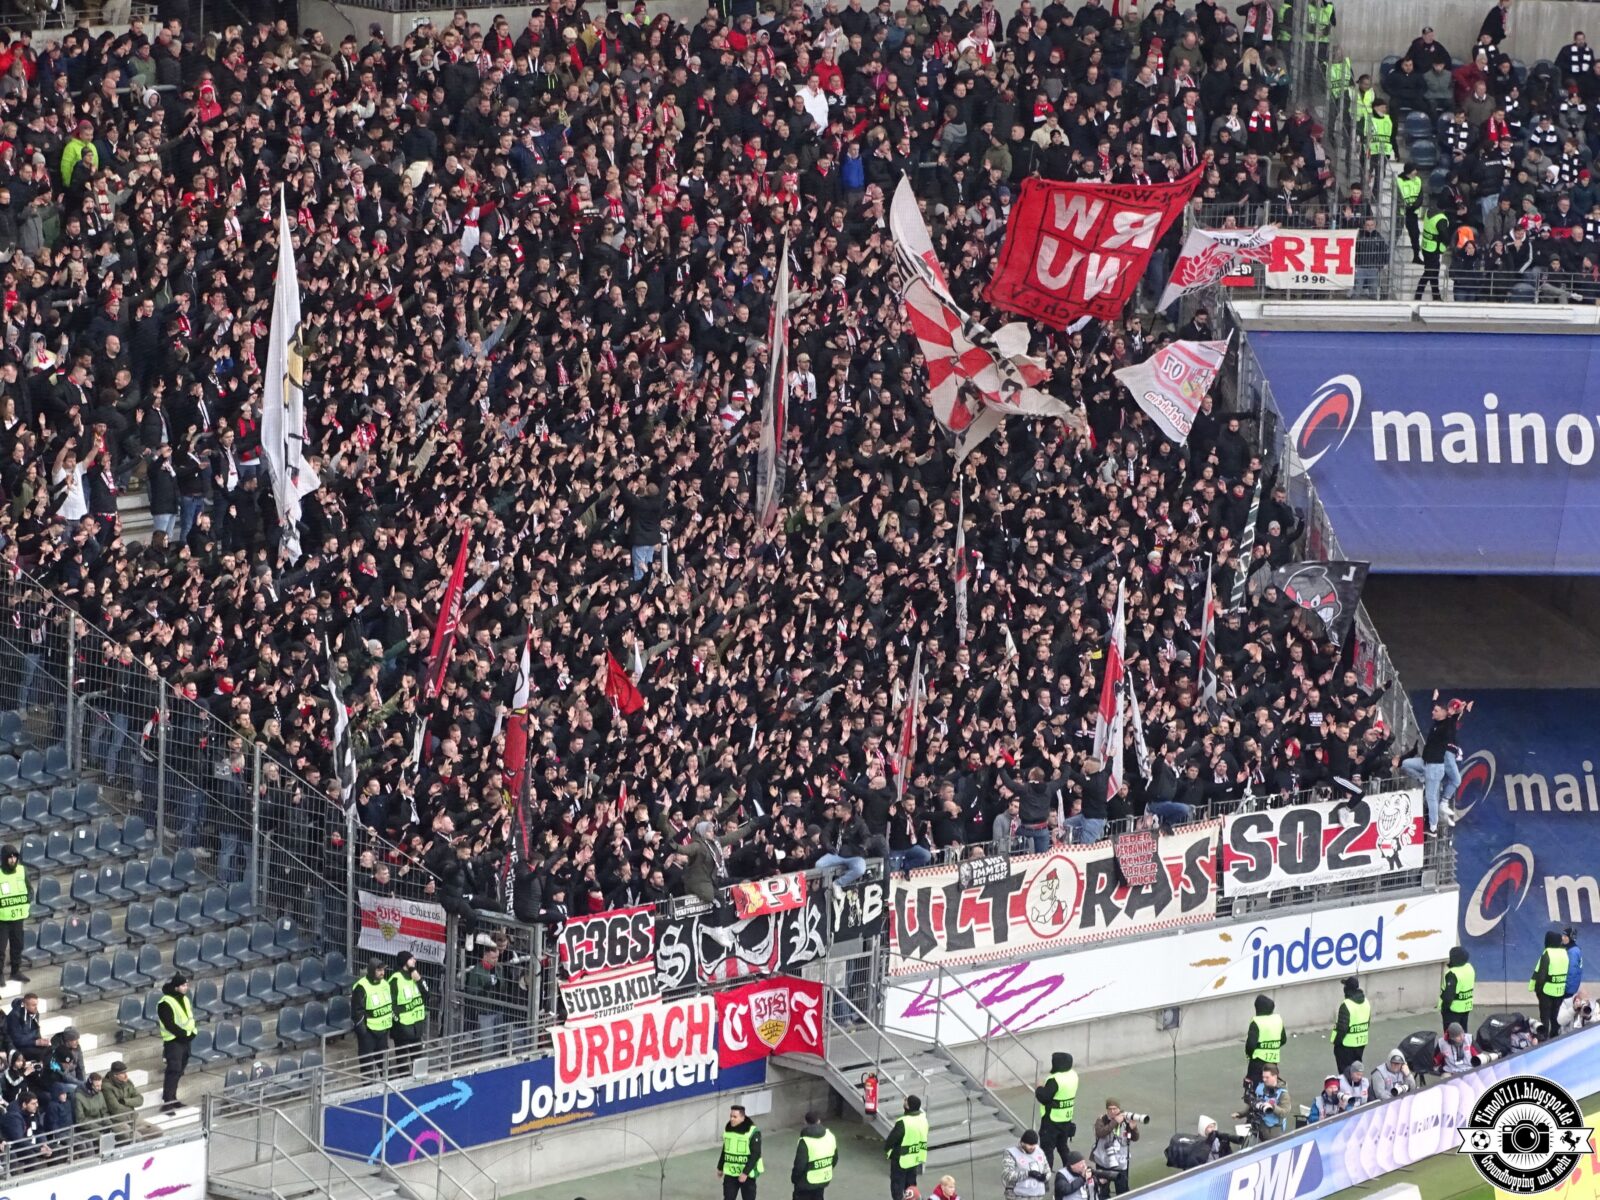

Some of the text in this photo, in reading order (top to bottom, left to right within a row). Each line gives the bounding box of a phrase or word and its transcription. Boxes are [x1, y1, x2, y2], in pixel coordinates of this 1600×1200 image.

[1268, 235, 1355, 275] RH
[1370, 392, 1600, 466] maino
[894, 836, 1213, 962] ULTRAS
[1250, 915, 1384, 981] indeed
[556, 1002, 711, 1085] URBACH
[594, 1003, 634, 1019] STUTTGART
